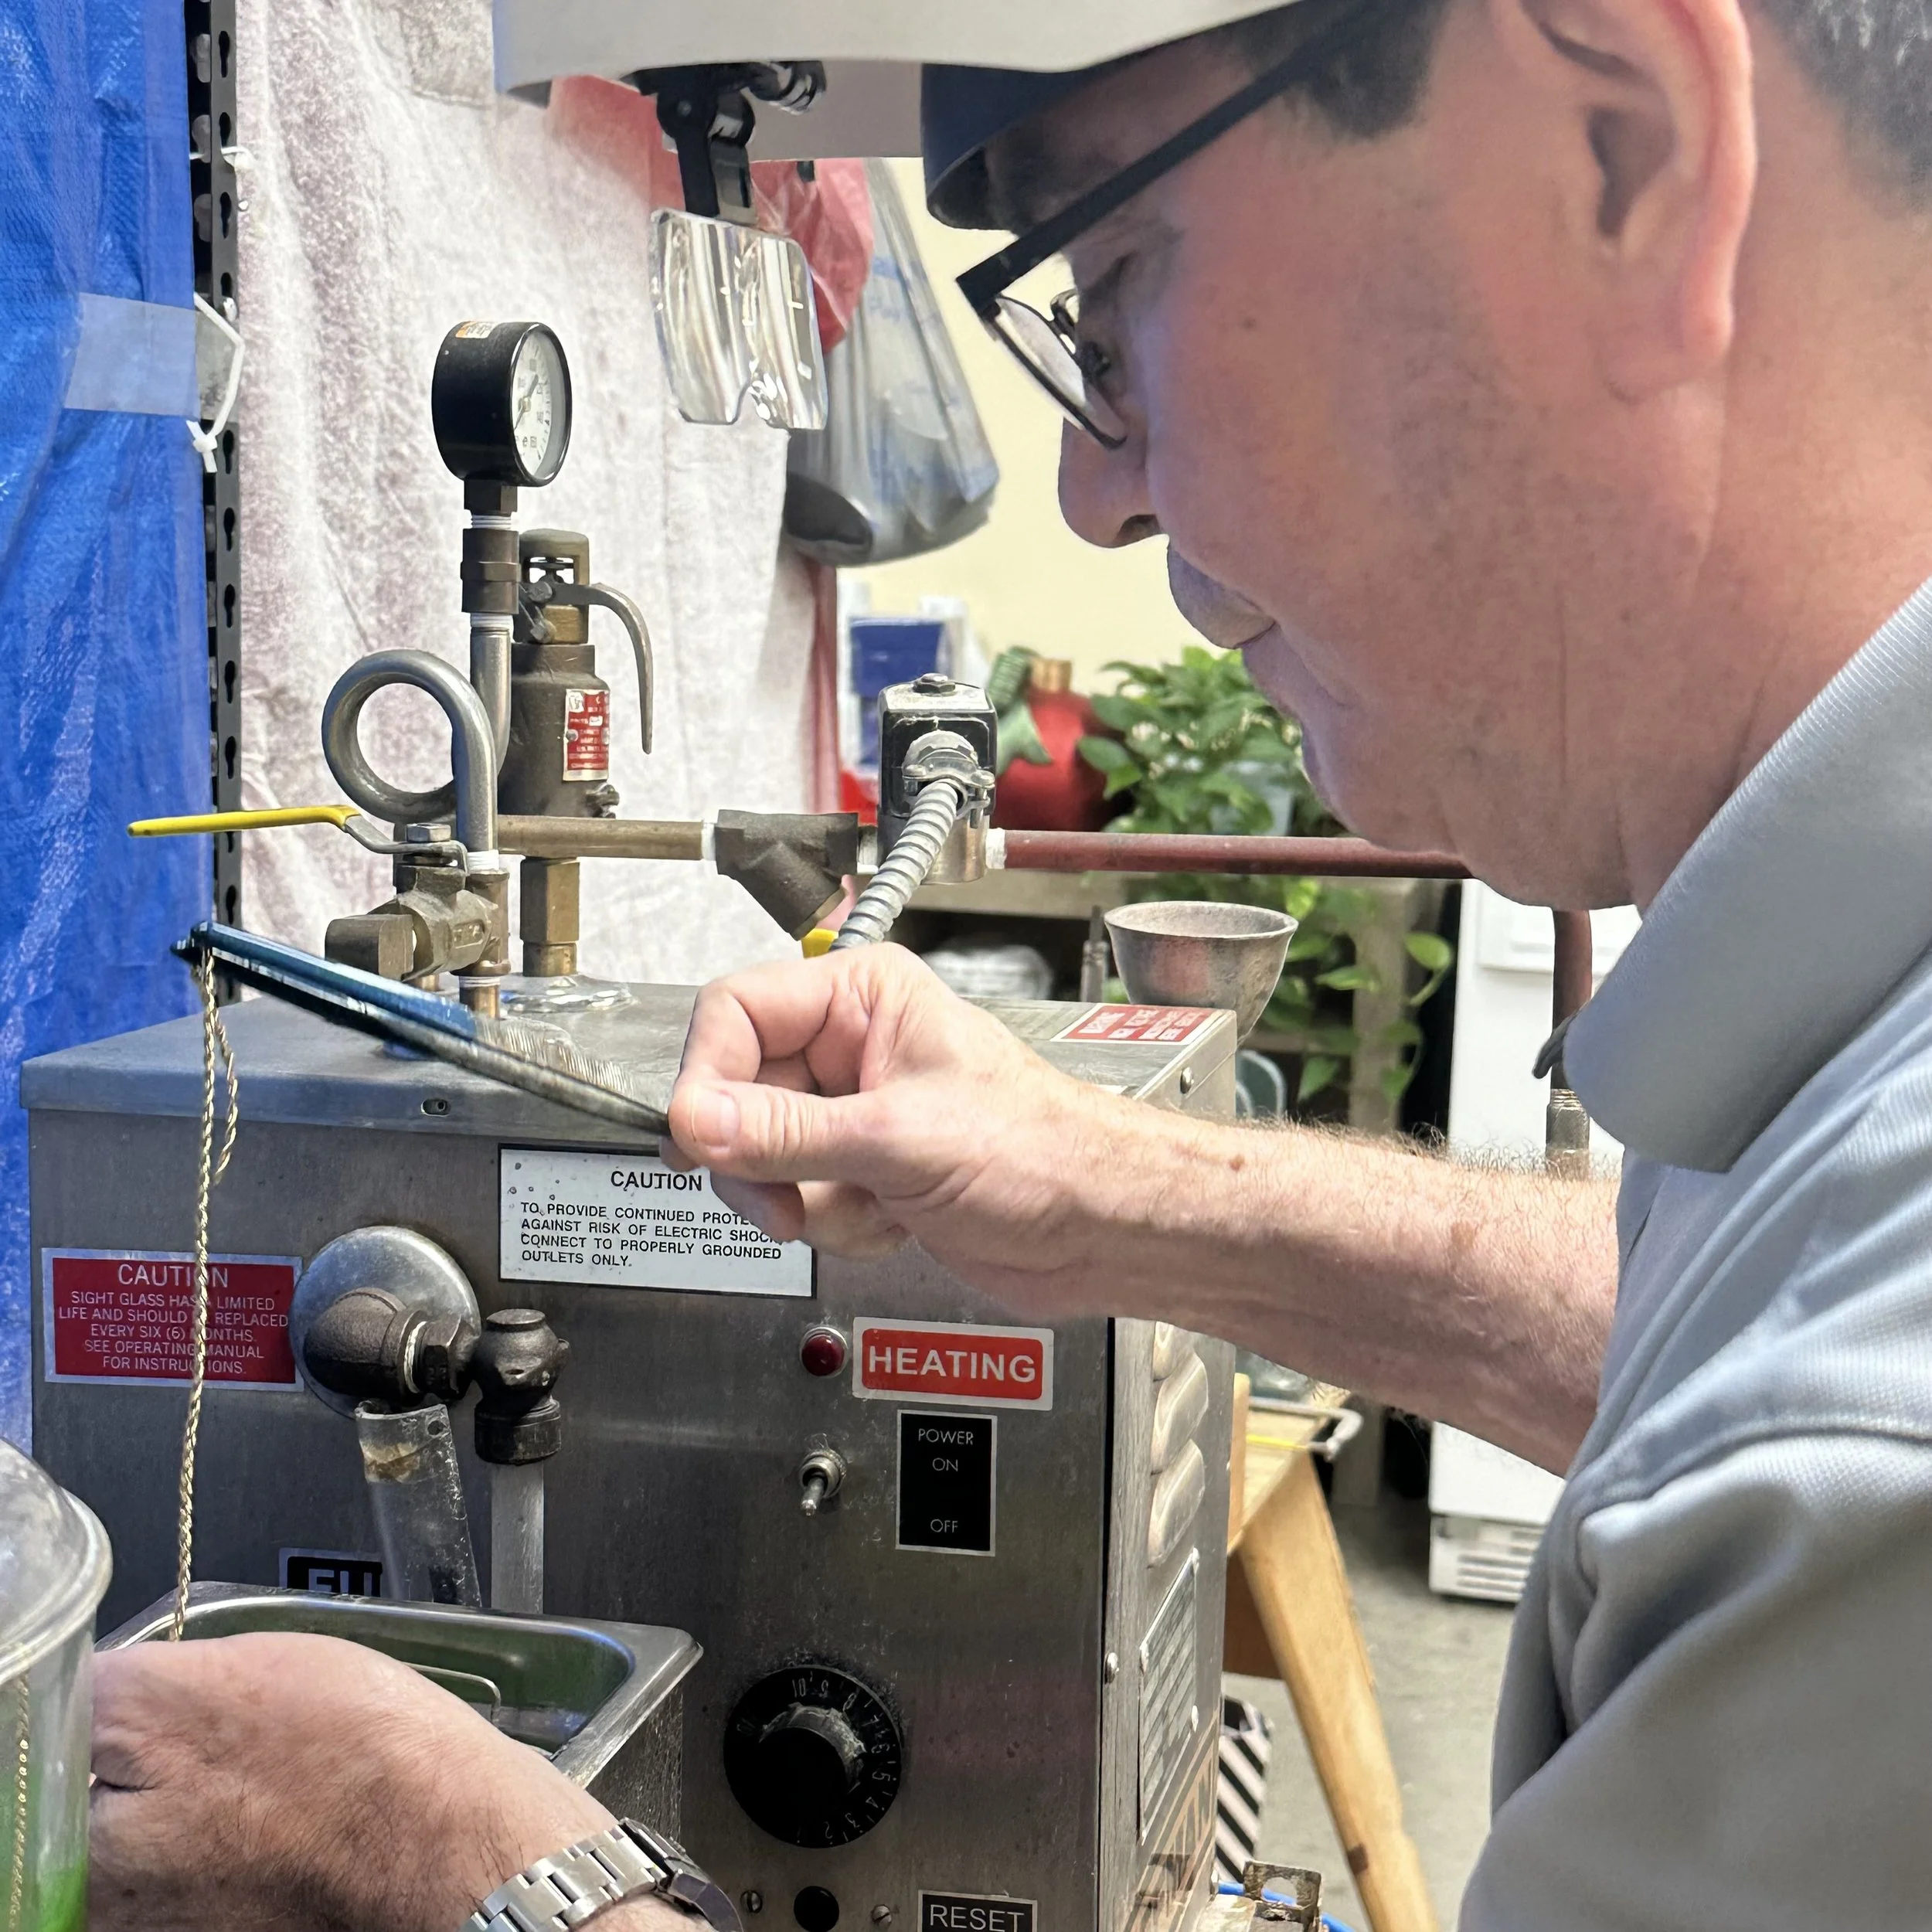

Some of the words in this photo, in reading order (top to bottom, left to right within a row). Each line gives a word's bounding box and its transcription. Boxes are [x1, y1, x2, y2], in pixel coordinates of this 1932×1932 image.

[610, 1171, 702, 1192] CAUTION
[521, 1202, 540, 1215] TO
[547, 1203, 607, 1218] PROVIDE
[615, 1207, 695, 1223] CONTINUED
[521, 1218, 582, 1233] AGAINST
[589, 1221, 621, 1235] RISK
[628, 1223, 647, 1236] OF
[655, 1225, 723, 1240] ELECTRIC
[521, 1233, 586, 1249] CONNECT
[594, 1237, 613, 1250] TO
[621, 1240, 695, 1255] PROPERLY
[702, 1243, 782, 1260] GROUNDED
[522, 1250, 584, 1264] OUTLETS
[591, 1253, 633, 1267] ONLY.
[71, 1291, 114, 1305] SIGHT
[120, 1293, 165, 1307] GLASS
[169, 1294, 198, 1308] HAS
[217, 1297, 275, 1311] LIMITED
[59, 1307, 87, 1320] LIFE
[91, 1308, 123, 1321] AND
[128, 1309, 188, 1324] SHOULD
[215, 1312, 289, 1328] REPLACED
[91, 1324, 134, 1338] EVERY
[139, 1326, 162, 1338] SIX
[166, 1326, 186, 1341] (6)
[84, 1340, 109, 1352] SEE
[115, 1341, 196, 1356] OPERATING
[103, 1355, 131, 1369] FOR
[869, 1345, 1036, 1383] HEATING
[918, 1428, 975, 1446] POWER
[932, 1458, 959, 1472] ON
[930, 1518, 959, 1534] OFF
[930, 1904, 1025, 1932] RESET
